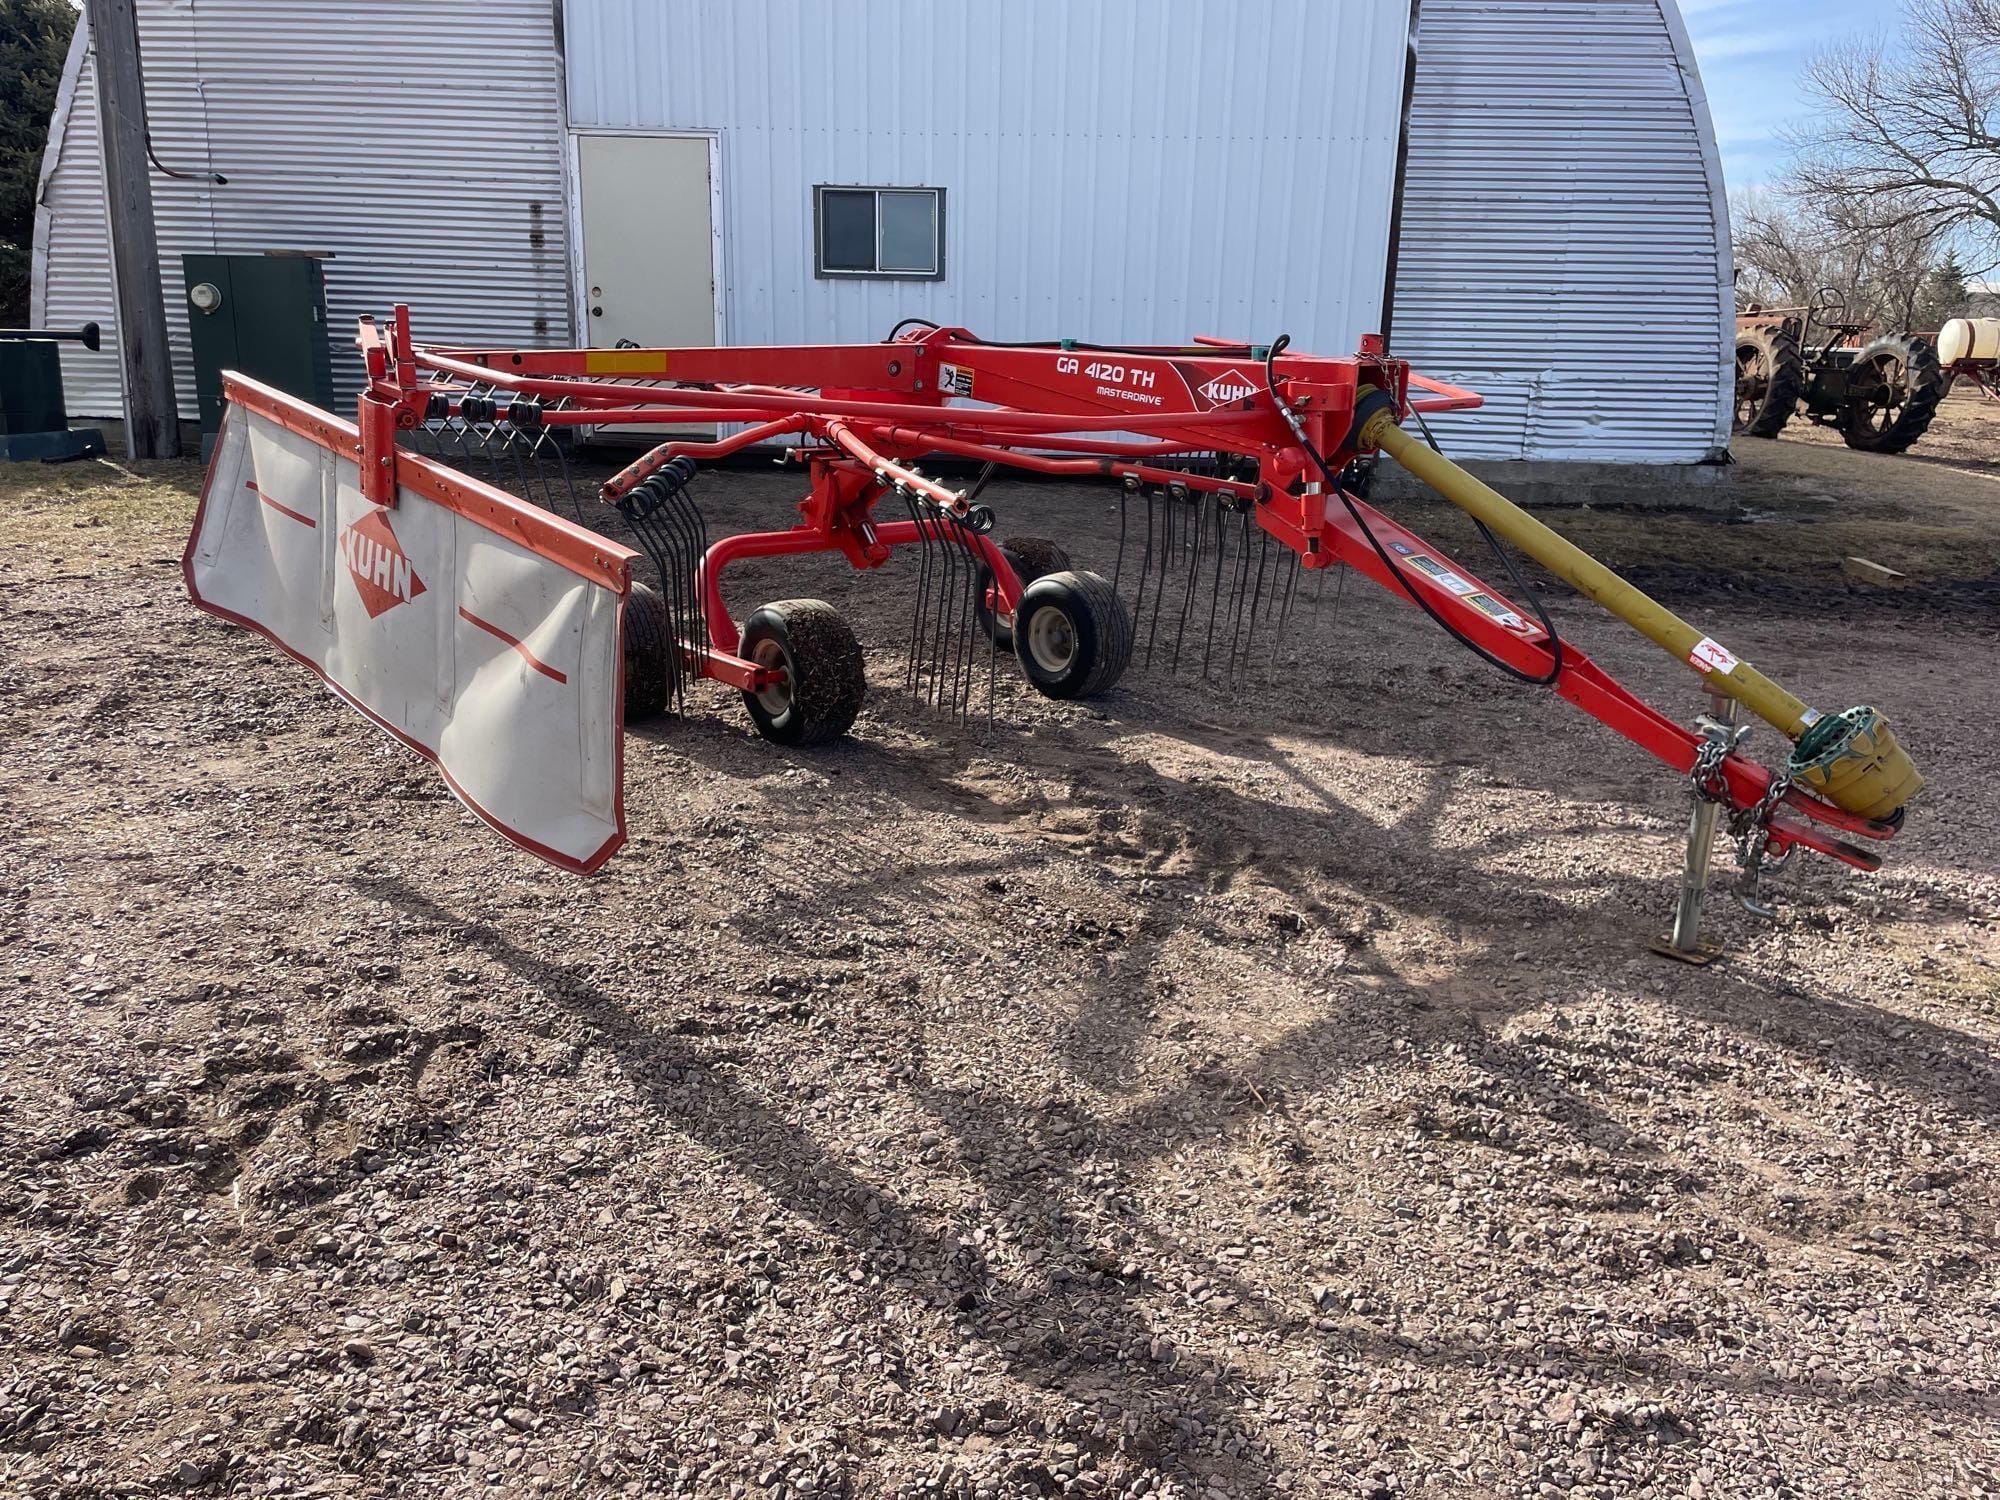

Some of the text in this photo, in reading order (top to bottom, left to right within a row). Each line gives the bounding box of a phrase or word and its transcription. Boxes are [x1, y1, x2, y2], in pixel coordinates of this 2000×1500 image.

[1057, 357, 1156, 389] GA 4120 TH
[1096, 386, 1162, 406] MASTERDRIVE
[345, 525, 412, 604] KUHN
